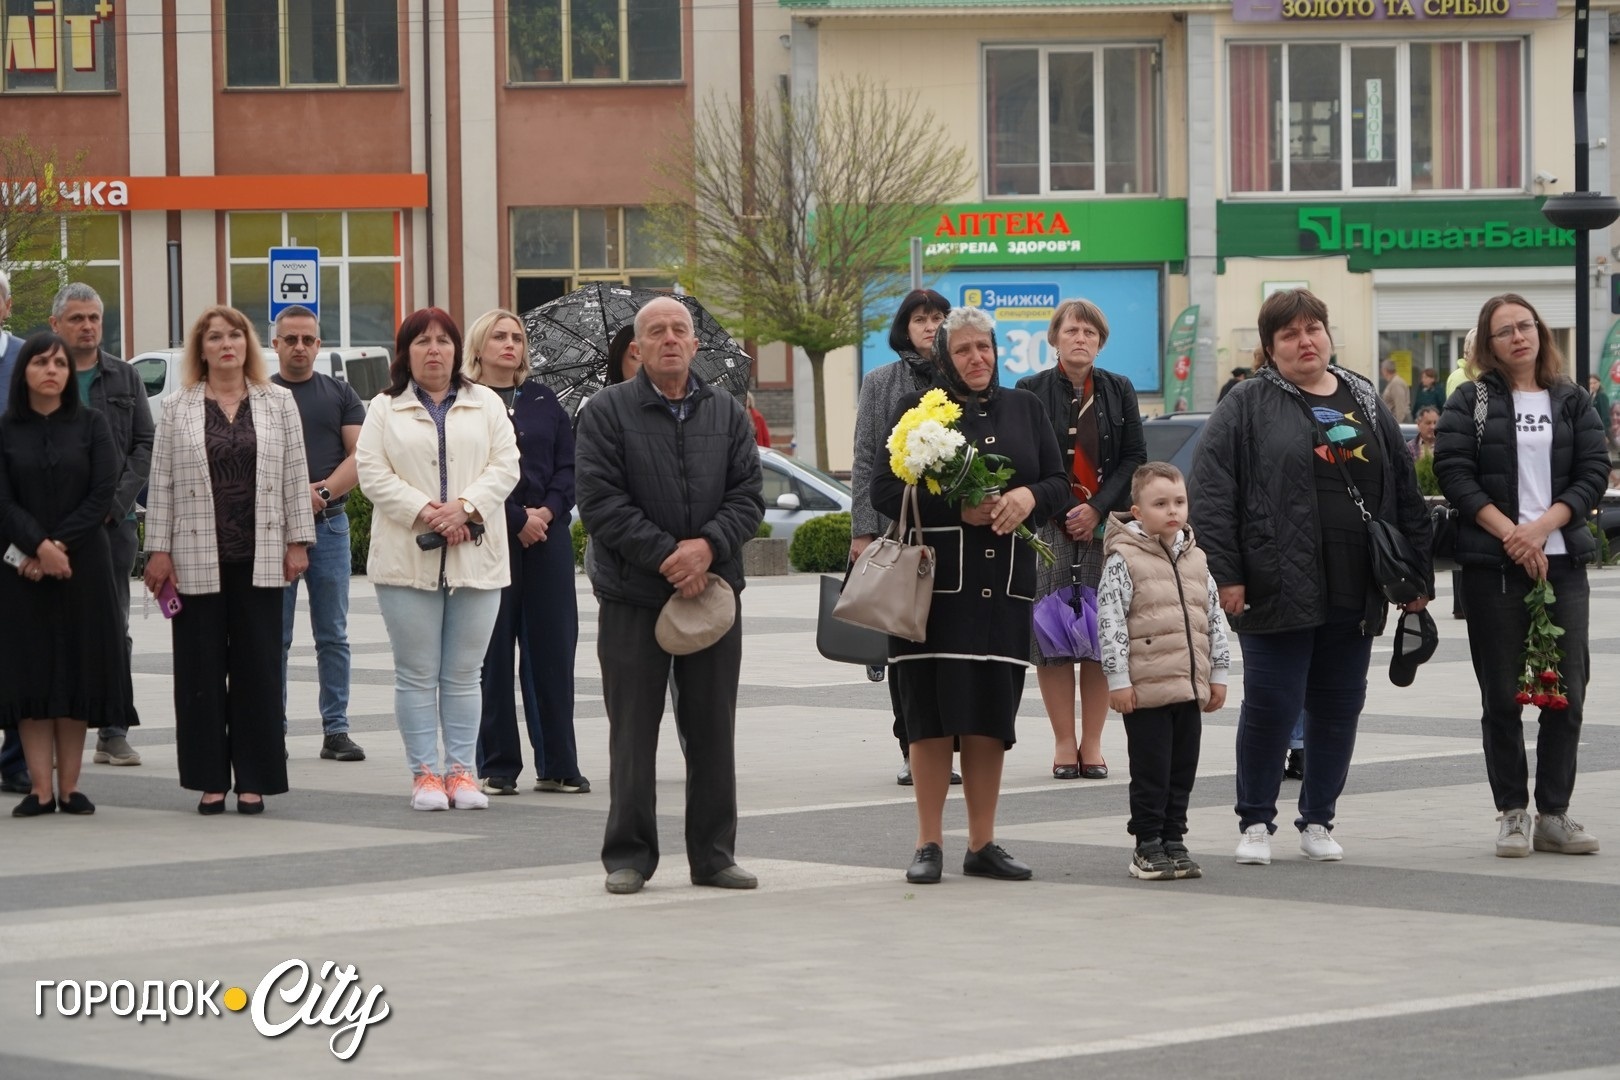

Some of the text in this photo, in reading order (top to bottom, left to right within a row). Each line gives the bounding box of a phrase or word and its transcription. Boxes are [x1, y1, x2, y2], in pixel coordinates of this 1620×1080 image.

[1282, 0, 1510, 18] ЗОЛОТО ТА СРІБЛО
[1368, 80, 1380, 160] ЗОЛОТО
[935, 212, 1071, 237] АПТЕКА
[1007, 240, 1081, 254] ЗДОРОВ'Я
[1345, 221, 1577, 255] ПриватБанк
[984, 290, 1055, 307] Знижки
